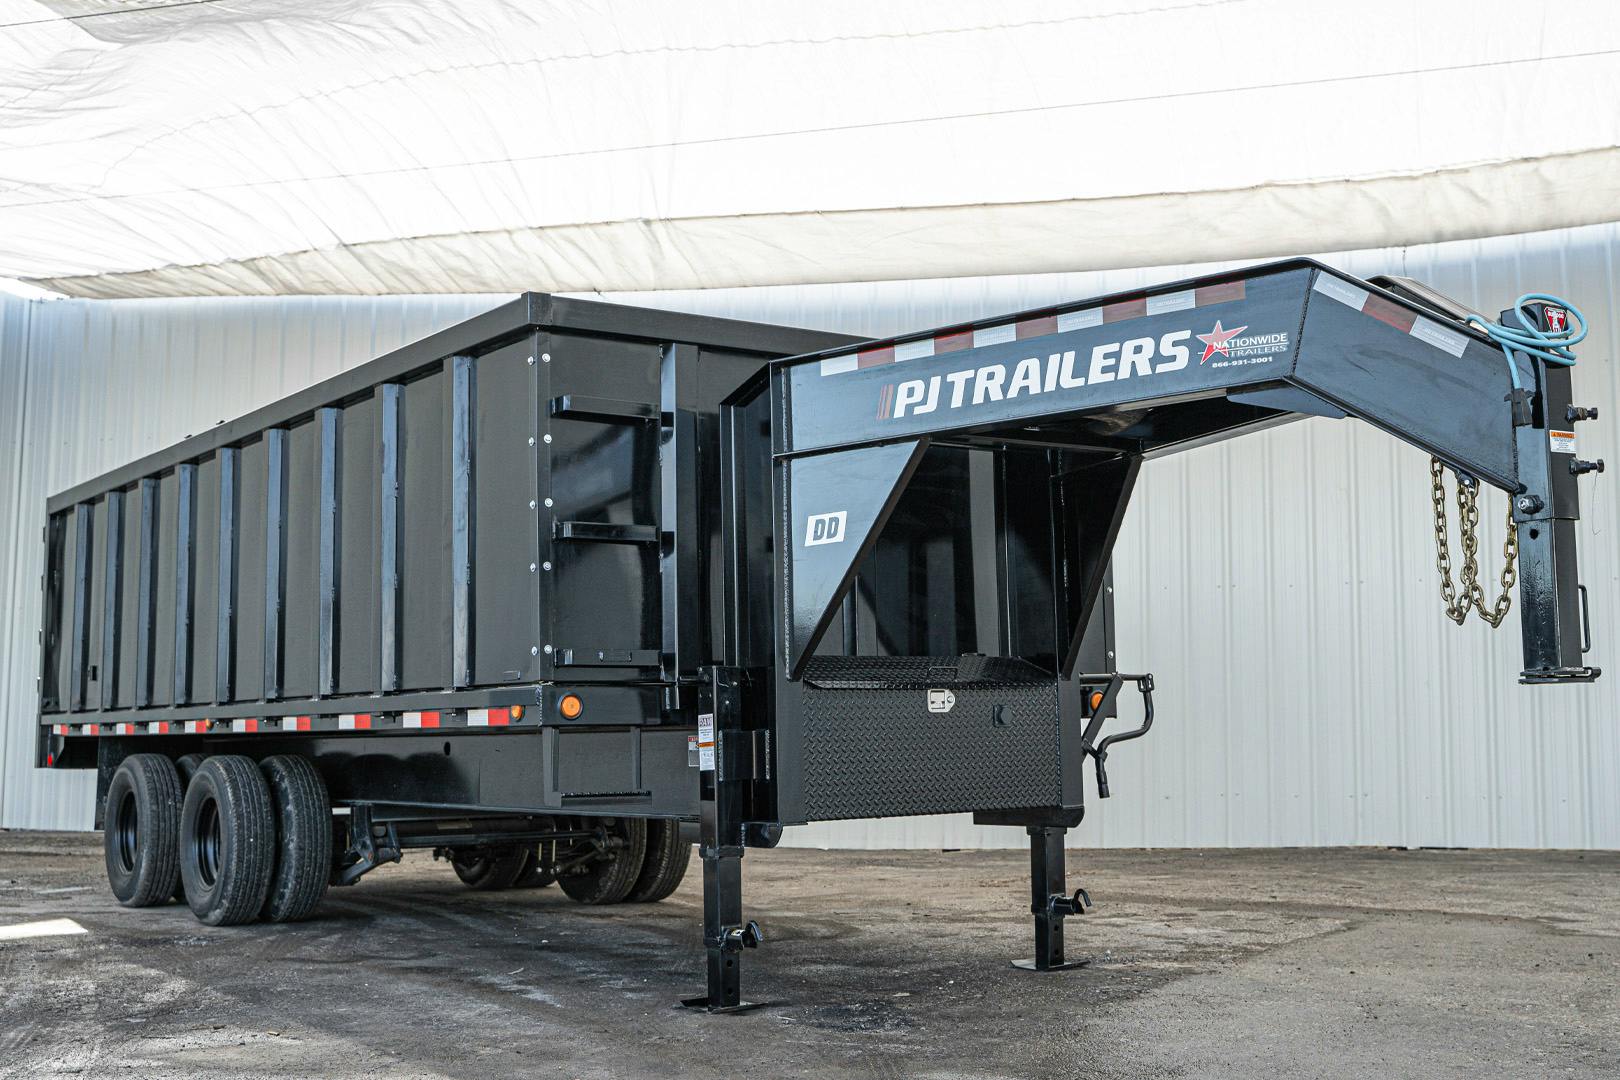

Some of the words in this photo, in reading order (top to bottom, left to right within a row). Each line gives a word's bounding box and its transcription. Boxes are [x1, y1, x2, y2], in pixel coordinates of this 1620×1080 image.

[1213, 333, 1288, 350] NATIONWIDE
[1231, 345, 1286, 357] TRAILERS
[1212, 356, 1273, 368] 866-931-3001
[812, 516, 840, 541] DD
